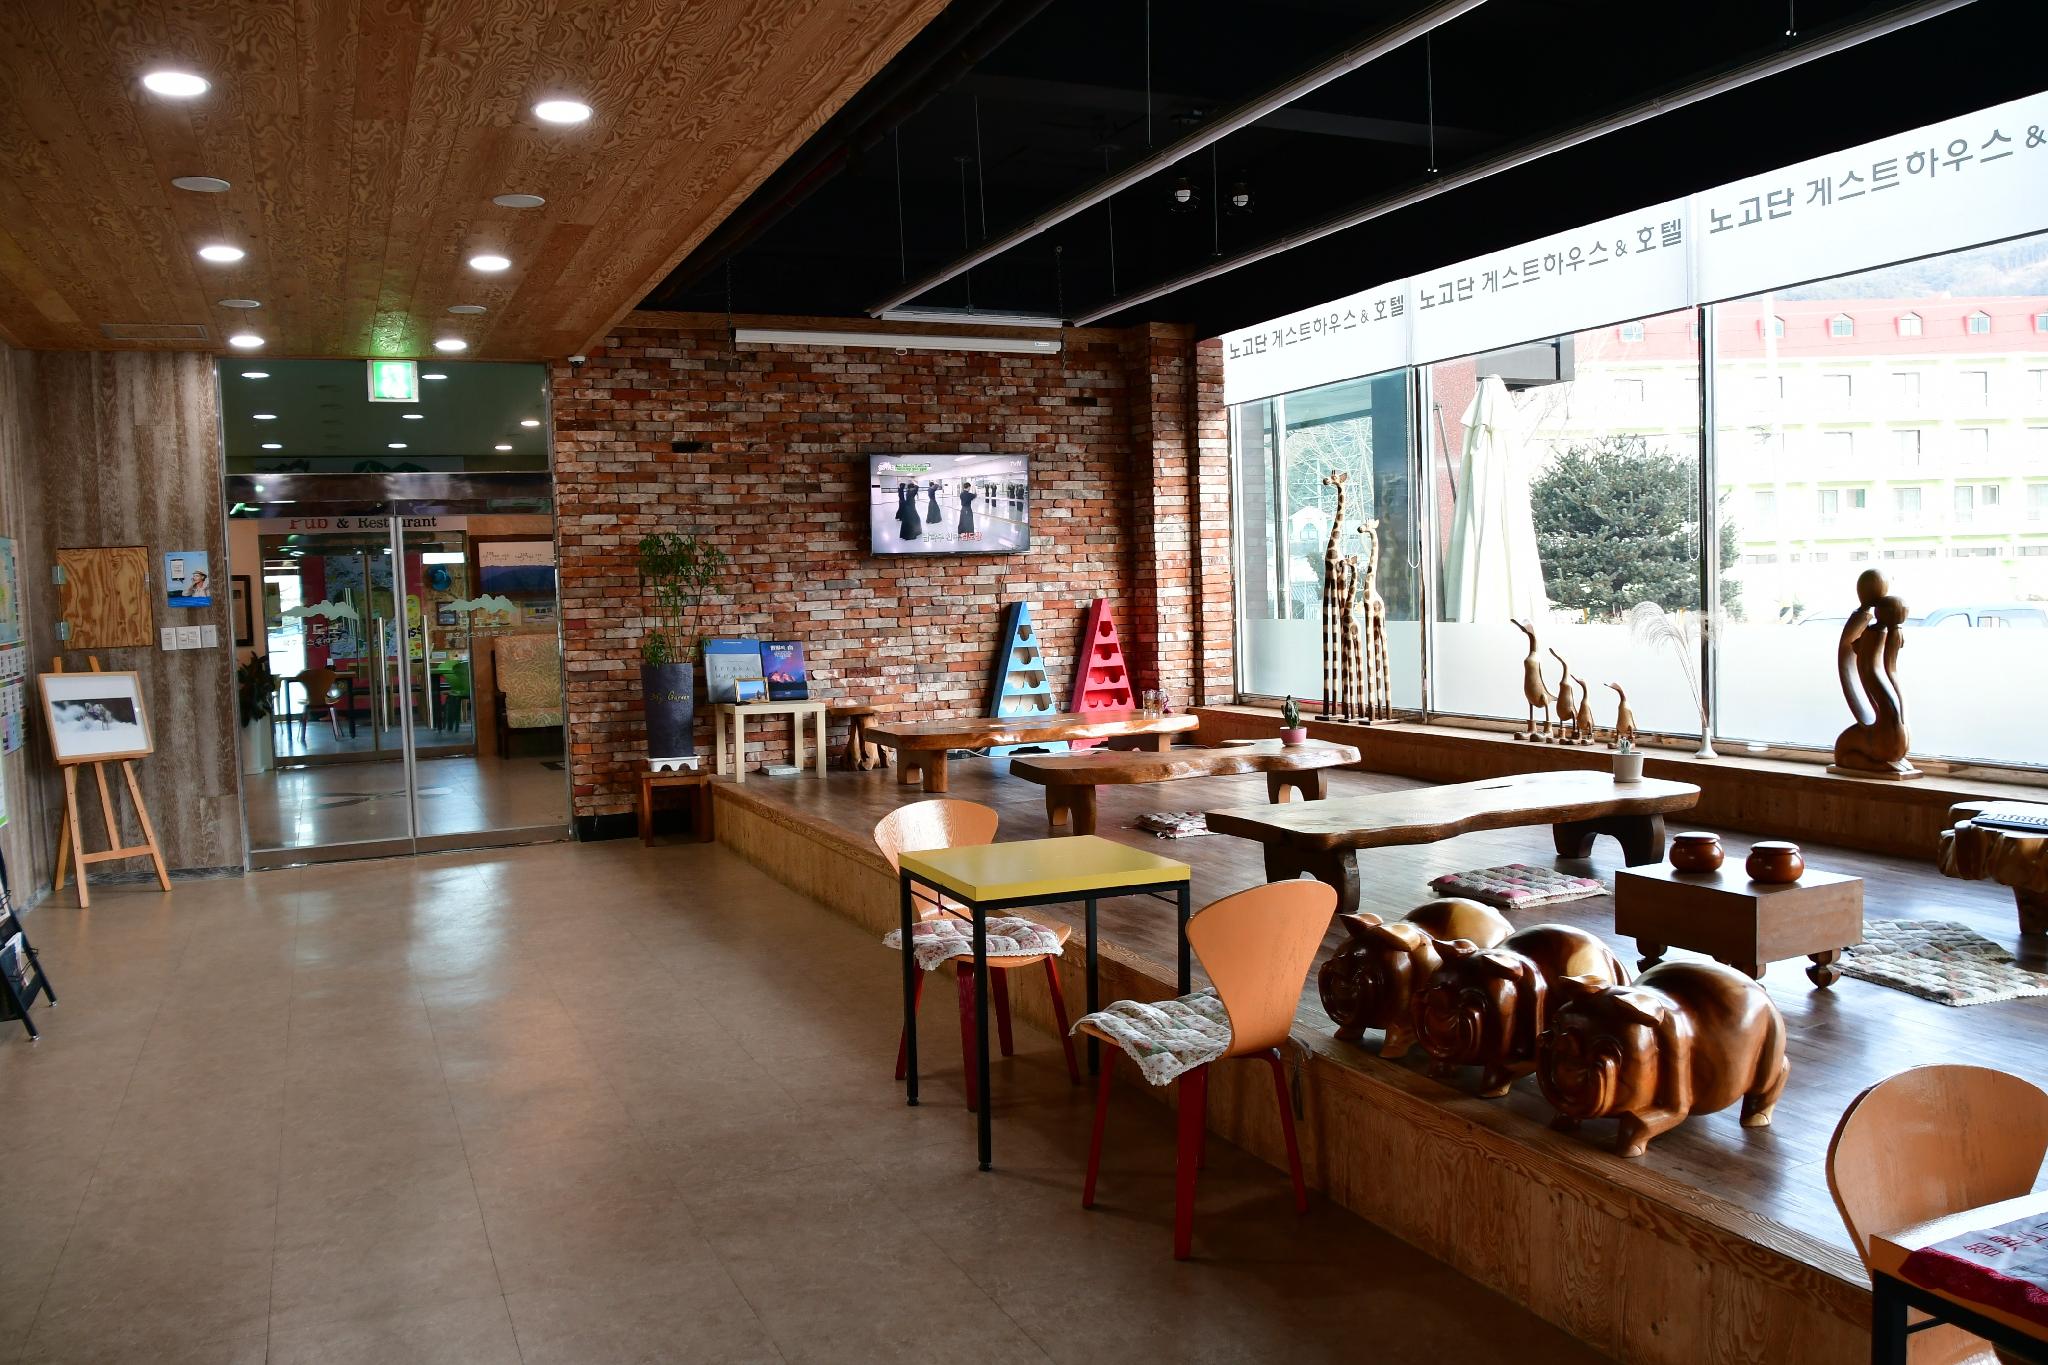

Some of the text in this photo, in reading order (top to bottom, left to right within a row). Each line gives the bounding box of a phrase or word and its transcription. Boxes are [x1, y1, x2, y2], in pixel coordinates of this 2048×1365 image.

[1709, 124, 2048, 234] 노고단 게스트하우스 &
[1418, 217, 1682, 311] 노고단 게스트하우스 & 호텔
[1229, 294, 1405, 360] 노고단 게스트하우스 & 호텔
[337, 517, 349, 530] &
[358, 516, 438, 529] Restrant
